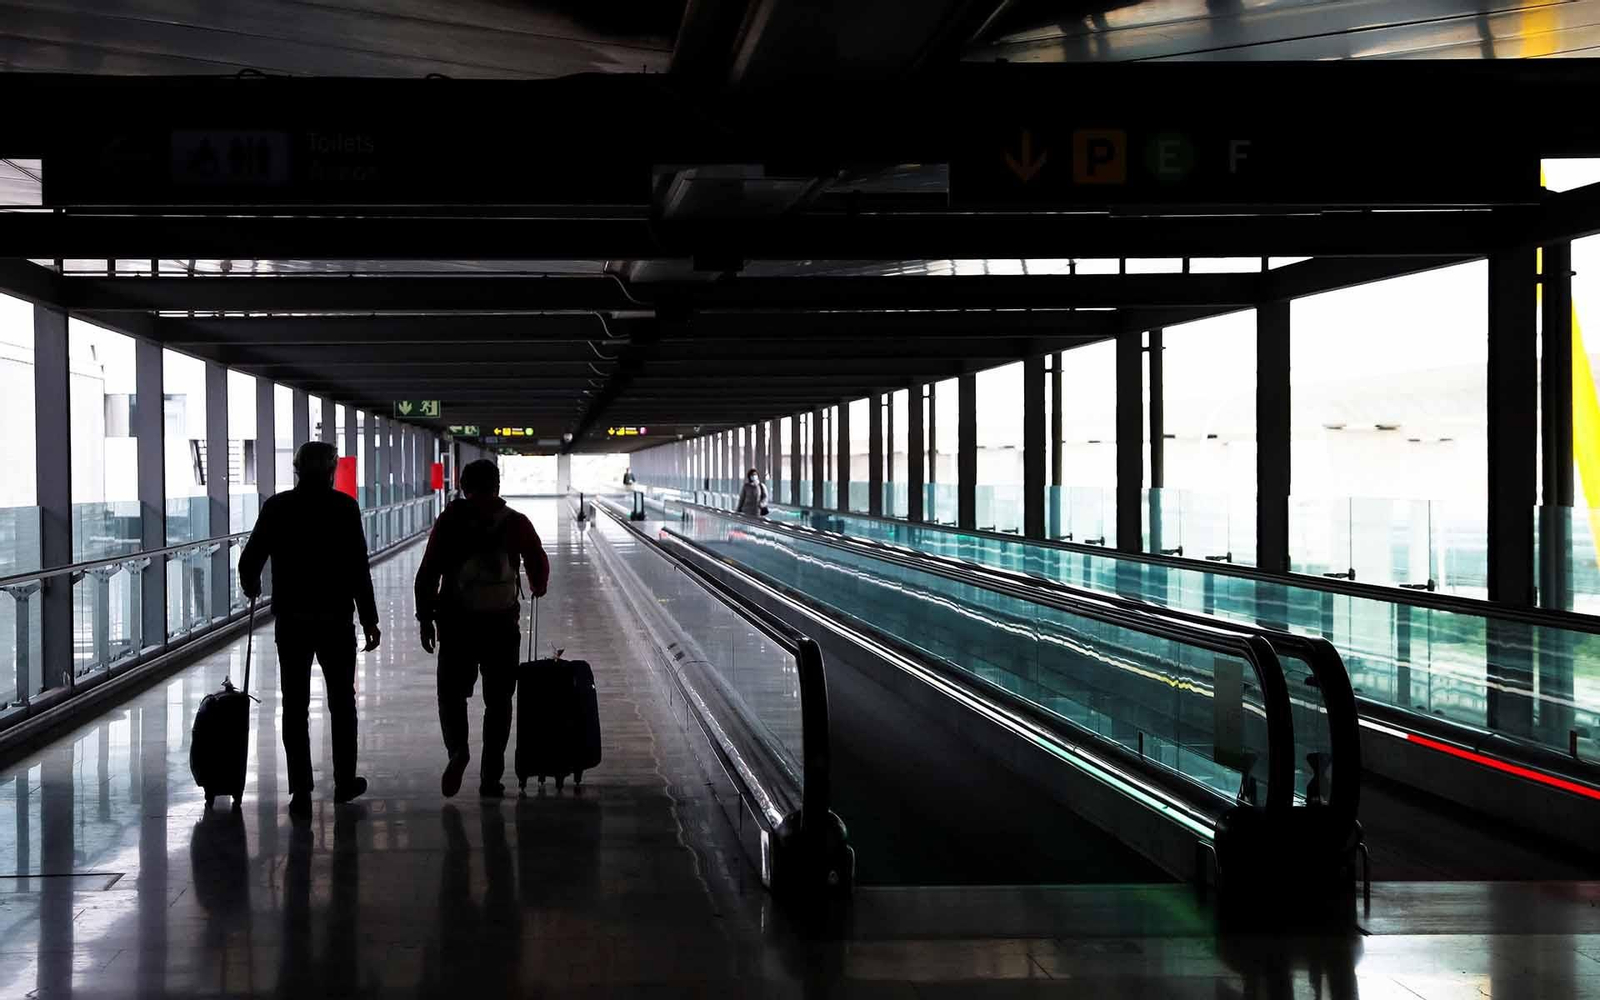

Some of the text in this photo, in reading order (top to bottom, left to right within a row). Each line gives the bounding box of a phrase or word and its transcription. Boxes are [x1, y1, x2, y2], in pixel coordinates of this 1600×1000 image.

[306, 132, 374, 153] Toilets
[1086, 138, 1252, 177] P E F
